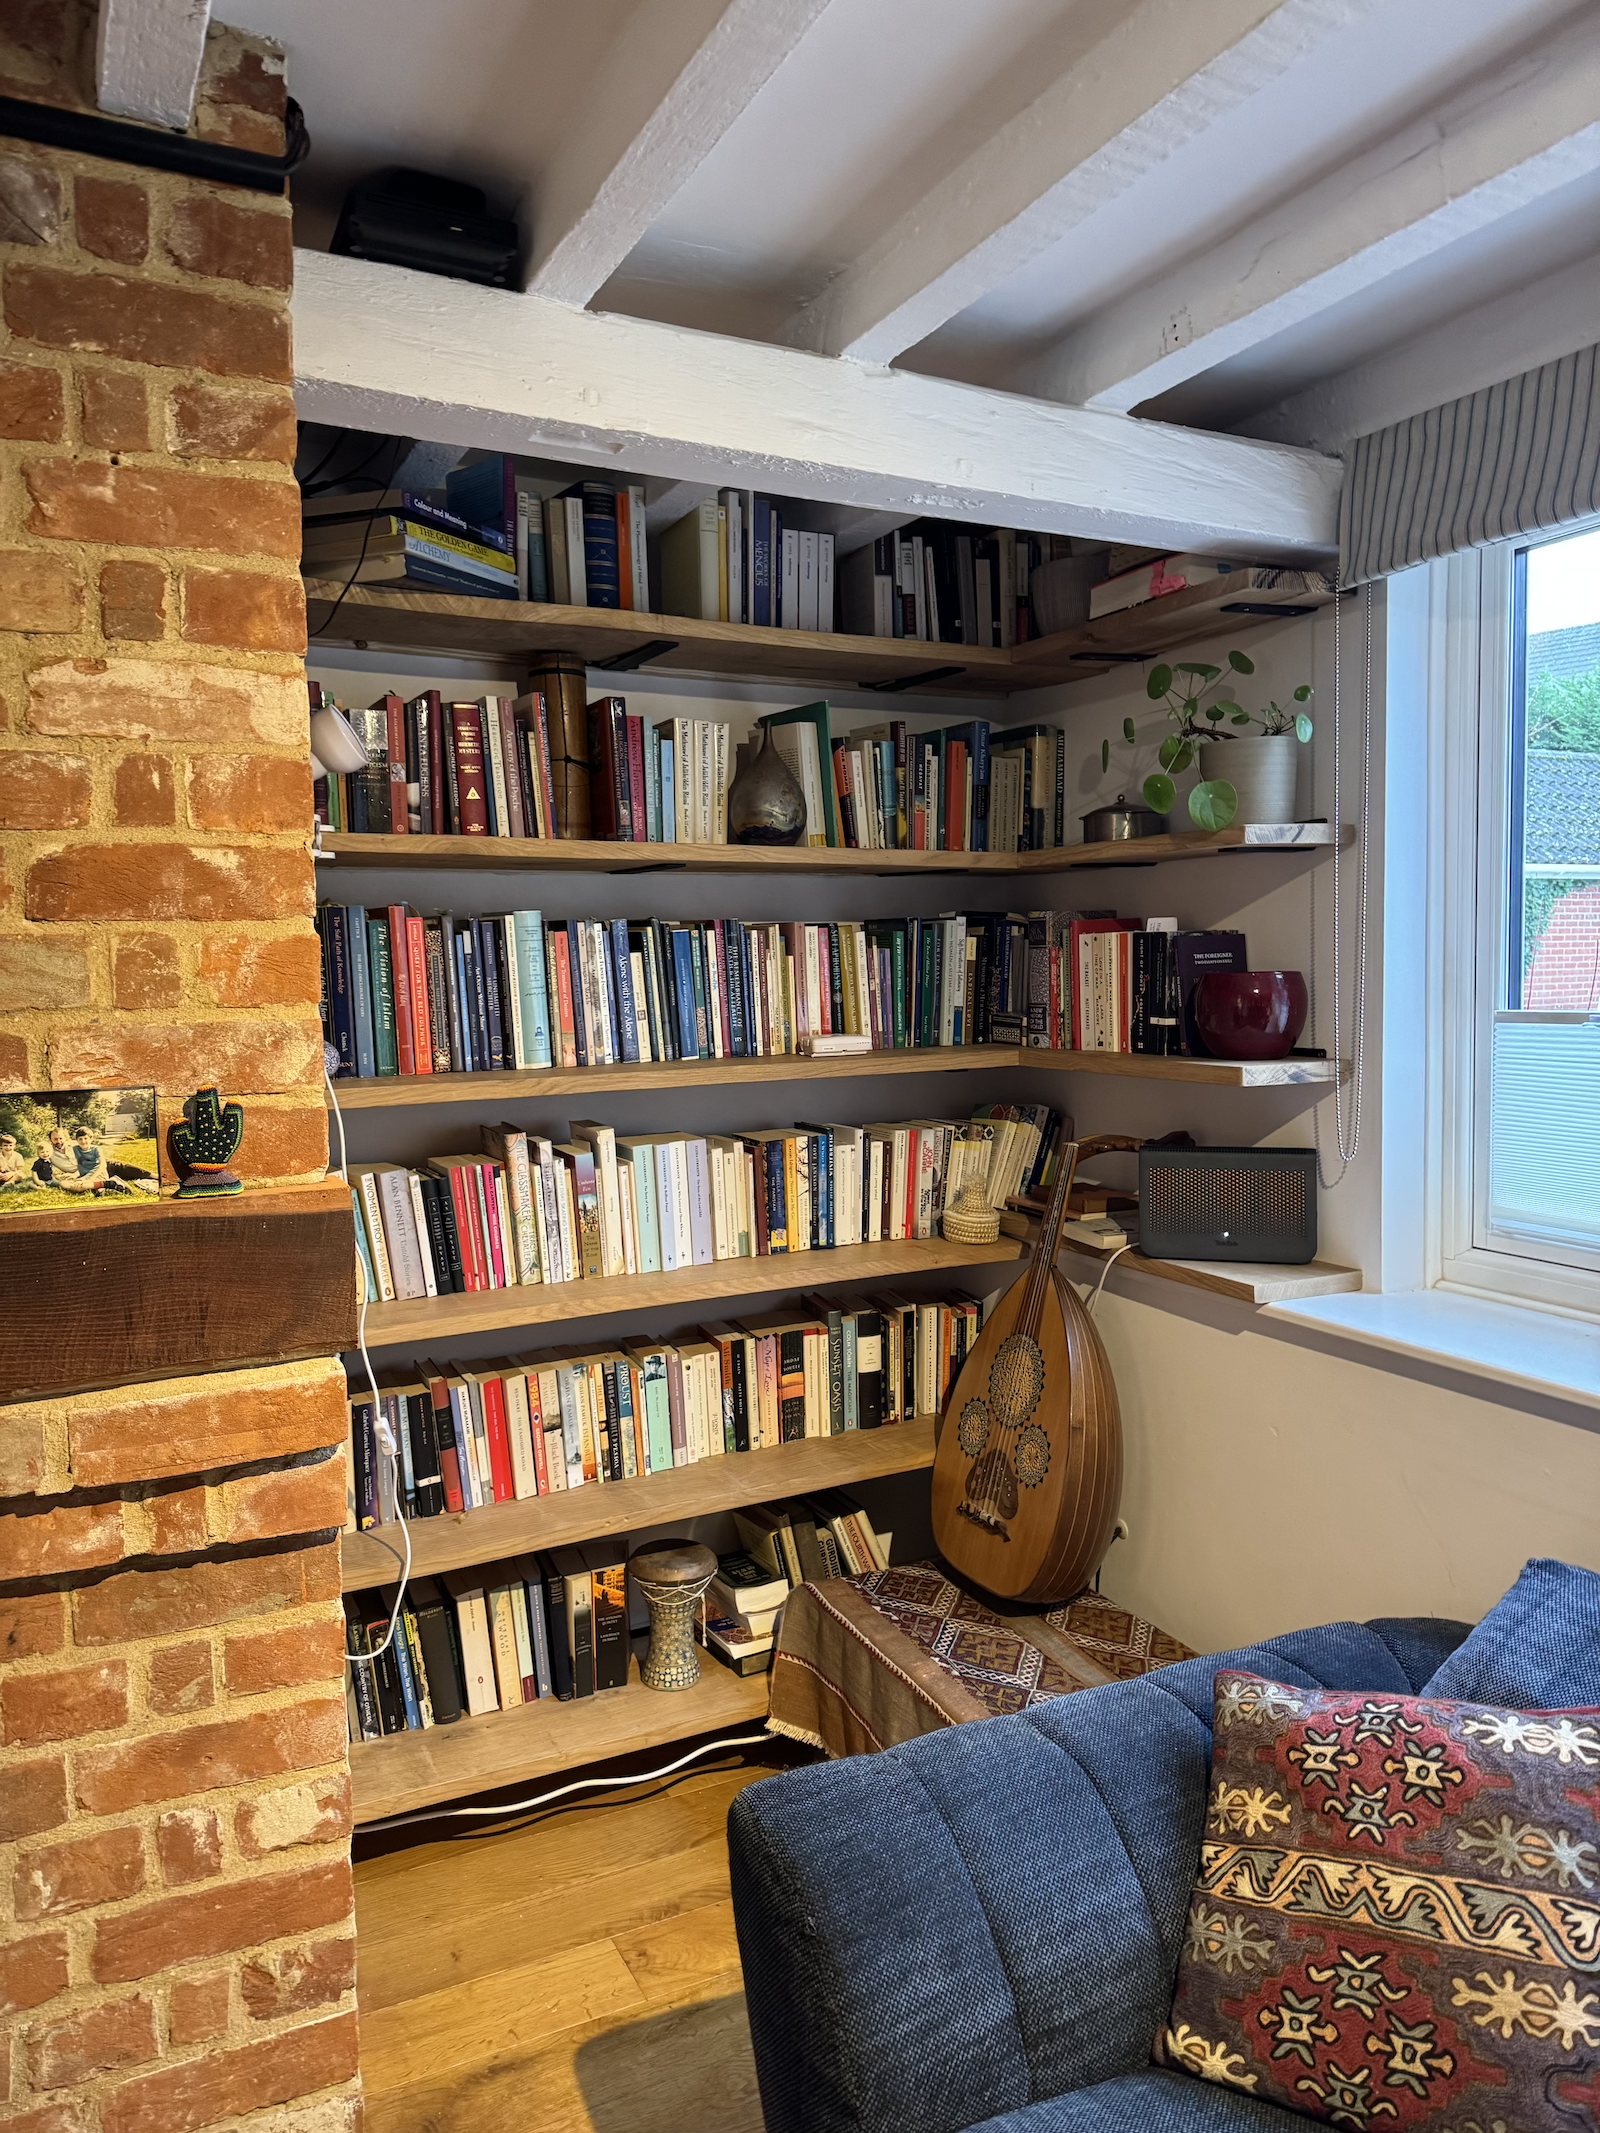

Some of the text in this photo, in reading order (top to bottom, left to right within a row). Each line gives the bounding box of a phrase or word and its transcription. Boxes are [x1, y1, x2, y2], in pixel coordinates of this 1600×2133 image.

[414, 498, 467, 529] Colour and Meaning
[419, 526, 488, 556] THE GOLDEN GAME
[754, 540, 763, 586] MENCIUS
[450, 745, 458, 773] ALCHEMY
[506, 729, 515, 762] Anatomy
[630, 720, 642, 799] Andrew Harvey
[509, 764, 516, 773] of
[841, 764, 849, 792] NOMAD
[1056, 734, 1064, 793] MUHAMMAD
[511, 786, 520, 812] Psyche
[647, 794, 654, 804] OF
[333, 916, 341, 928] The
[377, 926, 387, 945] The
[379, 951, 389, 983] Vision
[619, 955, 628, 978] Alone
[831, 947, 841, 990] APHORISMS
[381, 987, 390, 1000] of
[413, 947, 421, 968] QUEST
[418, 1016, 426, 1046] SULPHUR
[621, 980, 629, 1000] with
[733, 962, 742, 1016] REMEMBRANCE
[382, 1002, 391, 1030] Islam
[625, 1015, 633, 1039] Alone
[516, 1146, 526, 1160] THE
[933, 1130, 942, 1164] Lessing
[517, 1163, 532, 1223] GLASSMAKER
[366, 1183, 390, 1285] WOMEN TROY BARKER
[390, 1176, 412, 1285] ALAN BENNETT Untold Stories
[520, 1225, 530, 1263] CHEVALIER
[620, 1364, 630, 1405] PROUST
[724, 1359, 732, 1385] Smith
[764, 1373, 772, 1397] Love
[831, 1339, 841, 1412] SUNSET OASIS
[529, 1380, 538, 1408] 1984
[564, 1376, 574, 1428] ORHAN PAMUK
[361, 1409, 370, 1430] Gabriel
[578, 1381, 586, 1404] ORHAN
[583, 1428, 592, 1464] ISTANBUL
[550, 1442, 560, 1480] Black Book
[846, 1520, 865, 1558] THE FOURTH
[359, 1668, 368, 1693] COUNTRY
[405, 1687, 413, 1702] Wren
[362, 1694, 369, 1702] OF
